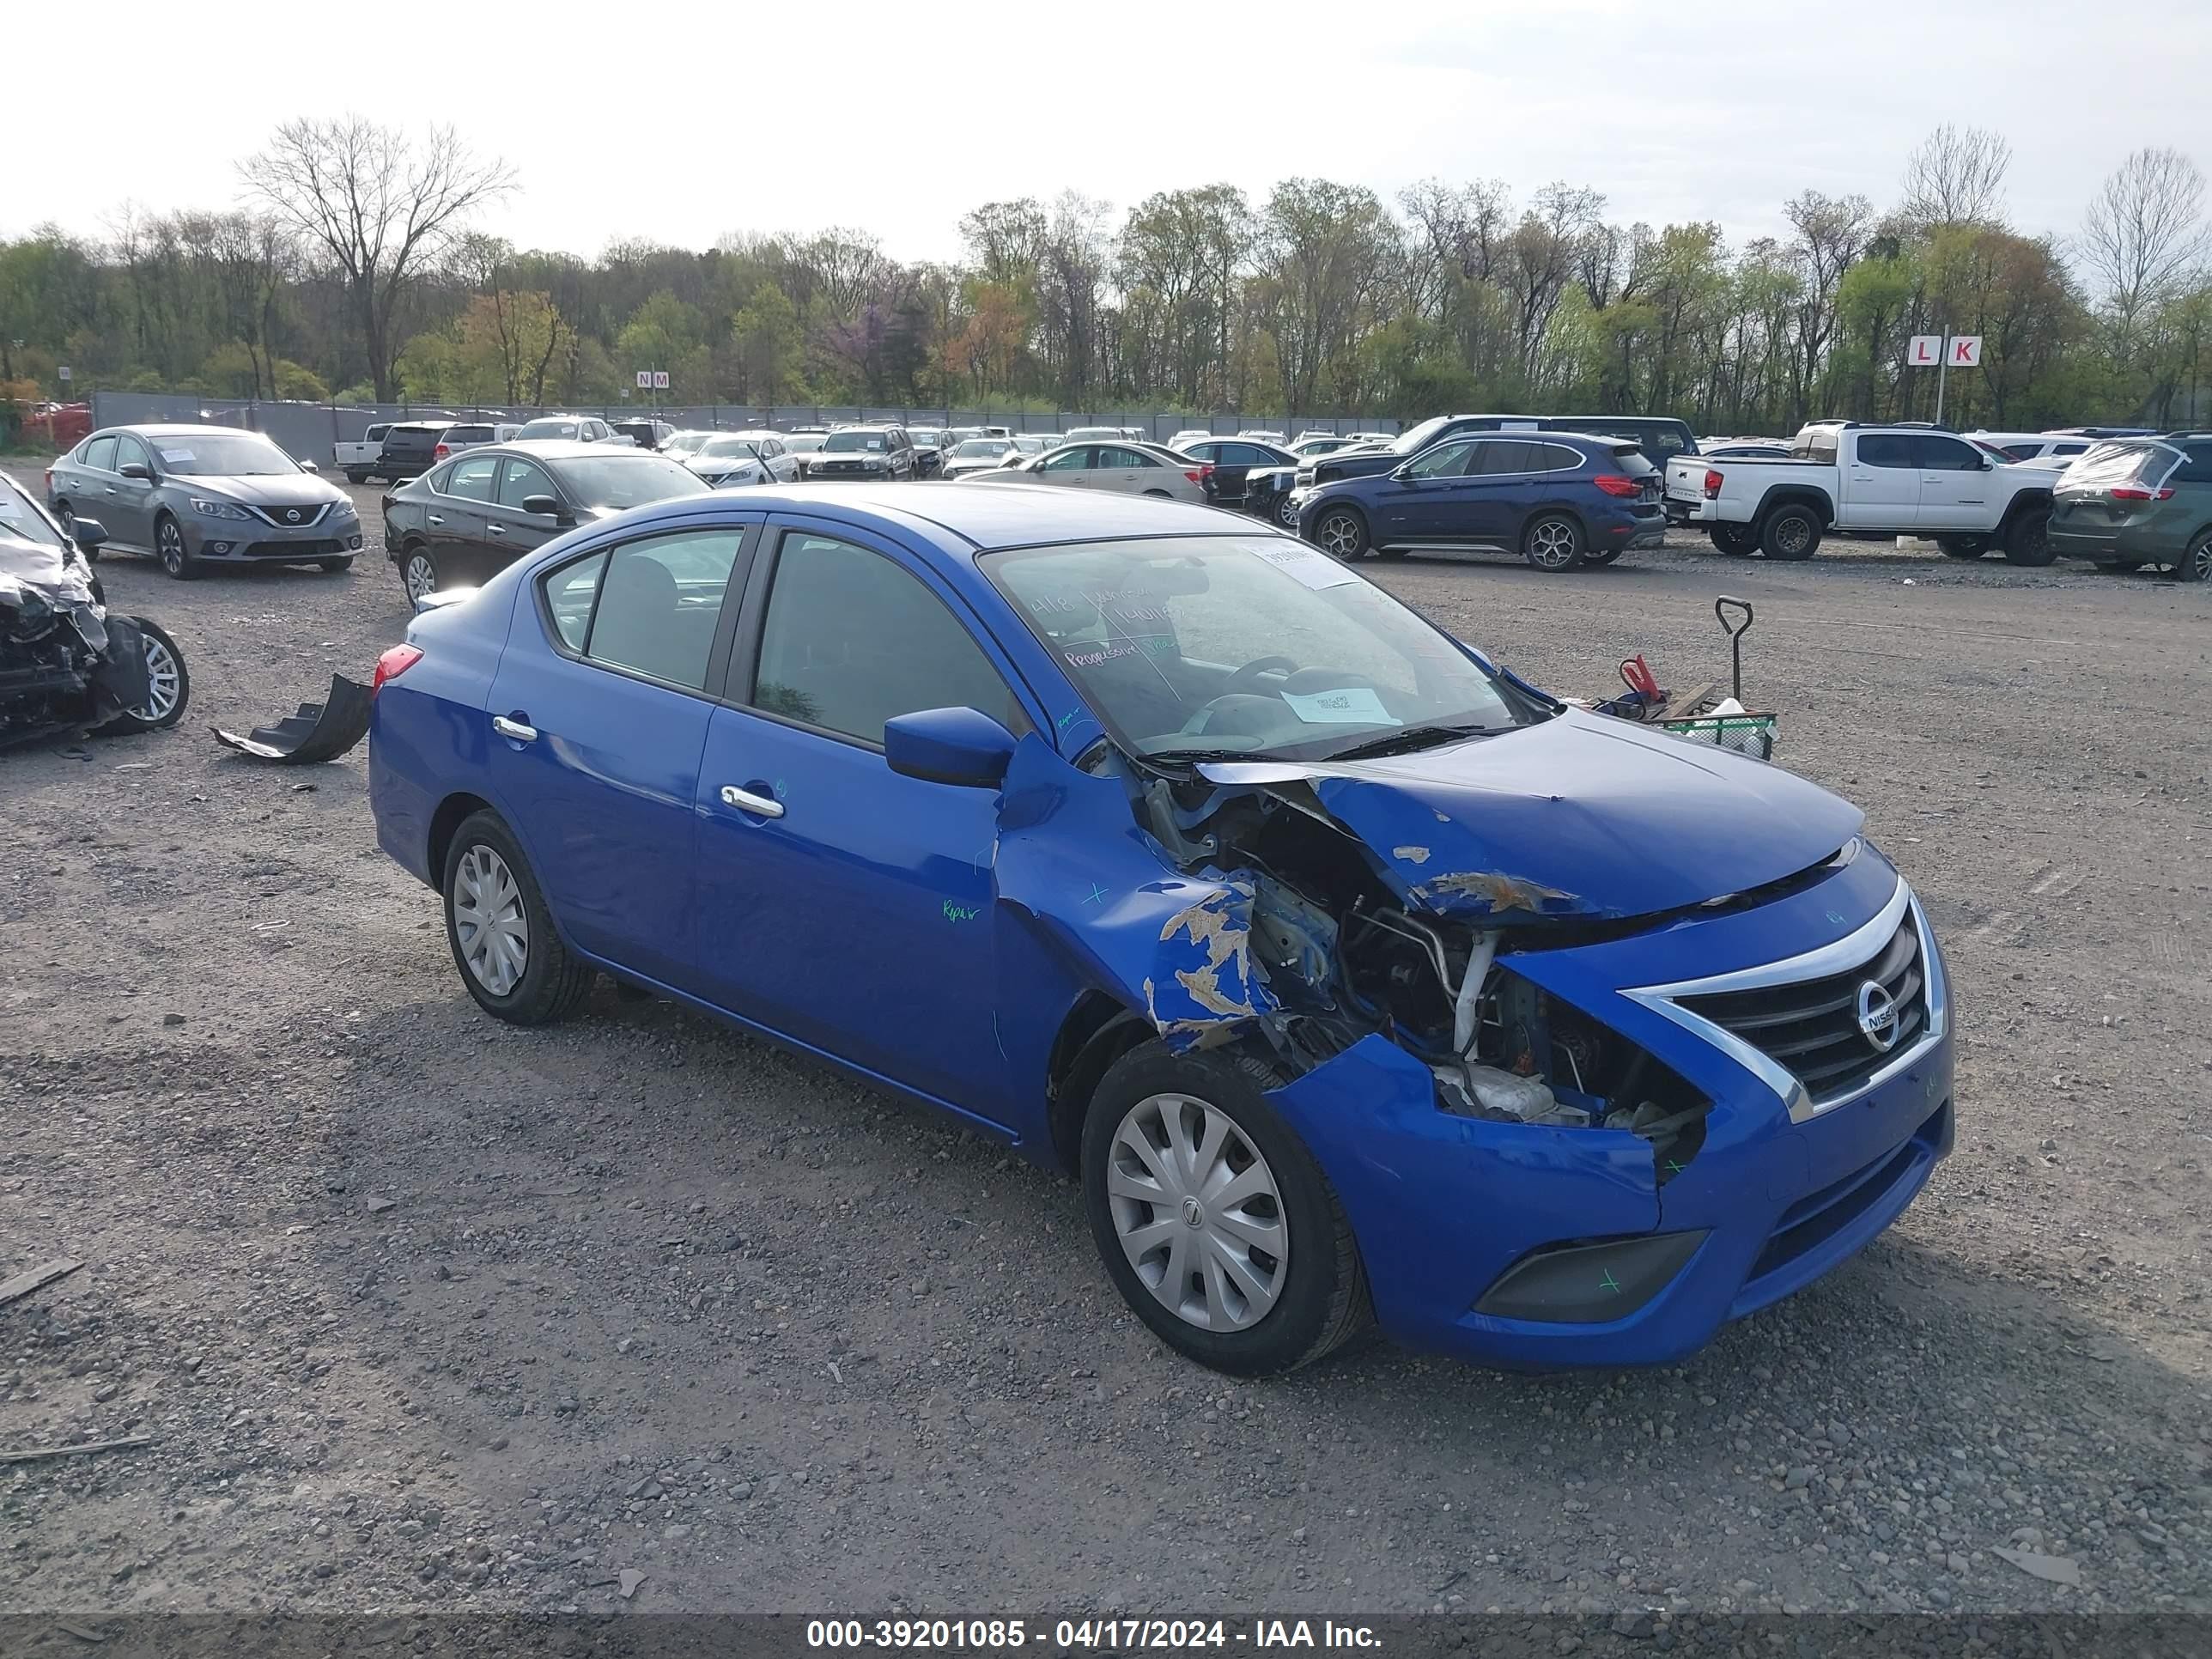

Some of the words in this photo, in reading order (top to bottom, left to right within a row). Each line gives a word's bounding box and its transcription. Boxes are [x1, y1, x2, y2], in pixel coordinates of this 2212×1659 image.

[1917, 342, 1931, 361] L
[1955, 342, 1974, 362] K
[640, 374, 649, 386] N
[656, 374, 667, 386] M
[1064, 645, 1140, 668] Progressive
[943, 899, 981, 923] Repair
